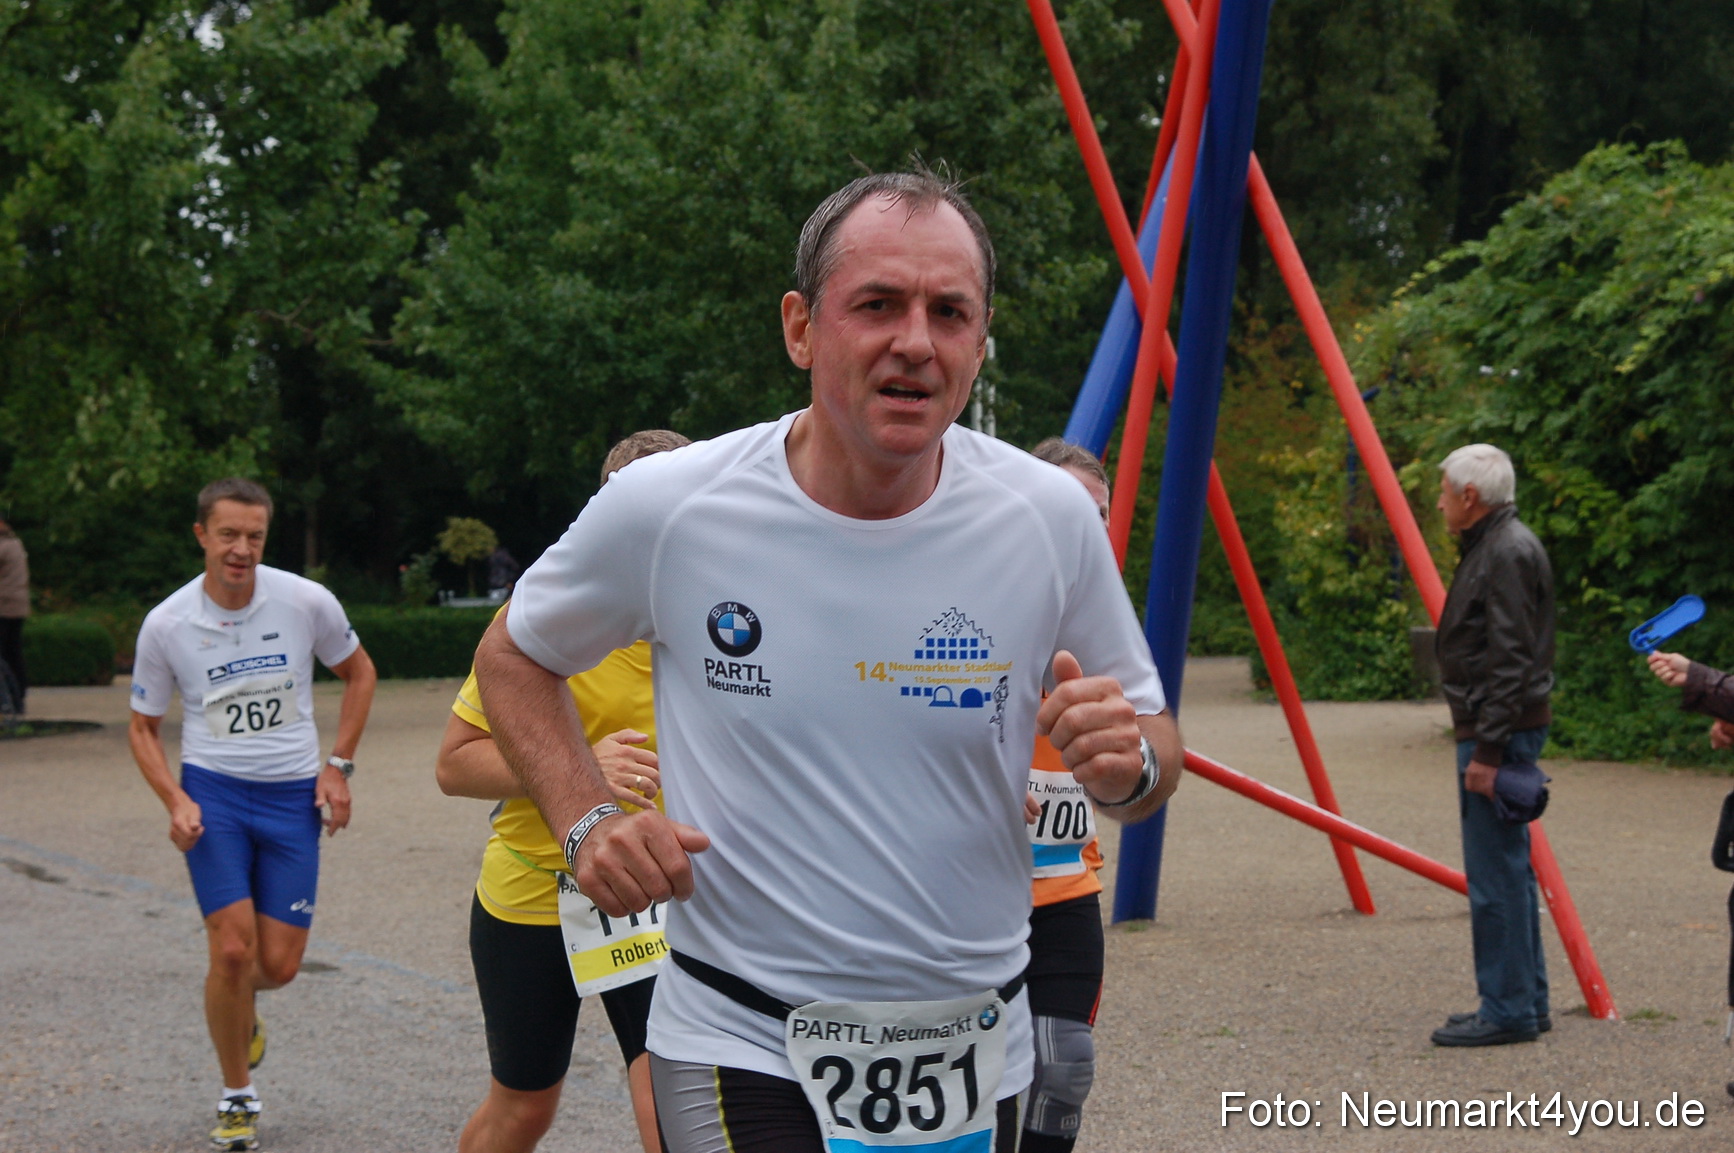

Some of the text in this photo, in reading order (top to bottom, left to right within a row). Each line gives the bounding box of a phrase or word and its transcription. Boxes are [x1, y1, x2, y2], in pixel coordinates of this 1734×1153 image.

[710, 603, 757, 623] BMW
[704, 657, 771, 683] PARTL
[853, 660, 1013, 682] 14. Neumarkter Stadtlauf
[706, 675, 772, 697] Neumarkt
[226, 698, 283, 734] 262
[1044, 784, 1083, 795] Neumarkt
[611, 938, 668, 967] Robert
[792, 1015, 972, 1045] PARTL Neumarkt
[811, 1043, 979, 1135] 2851
